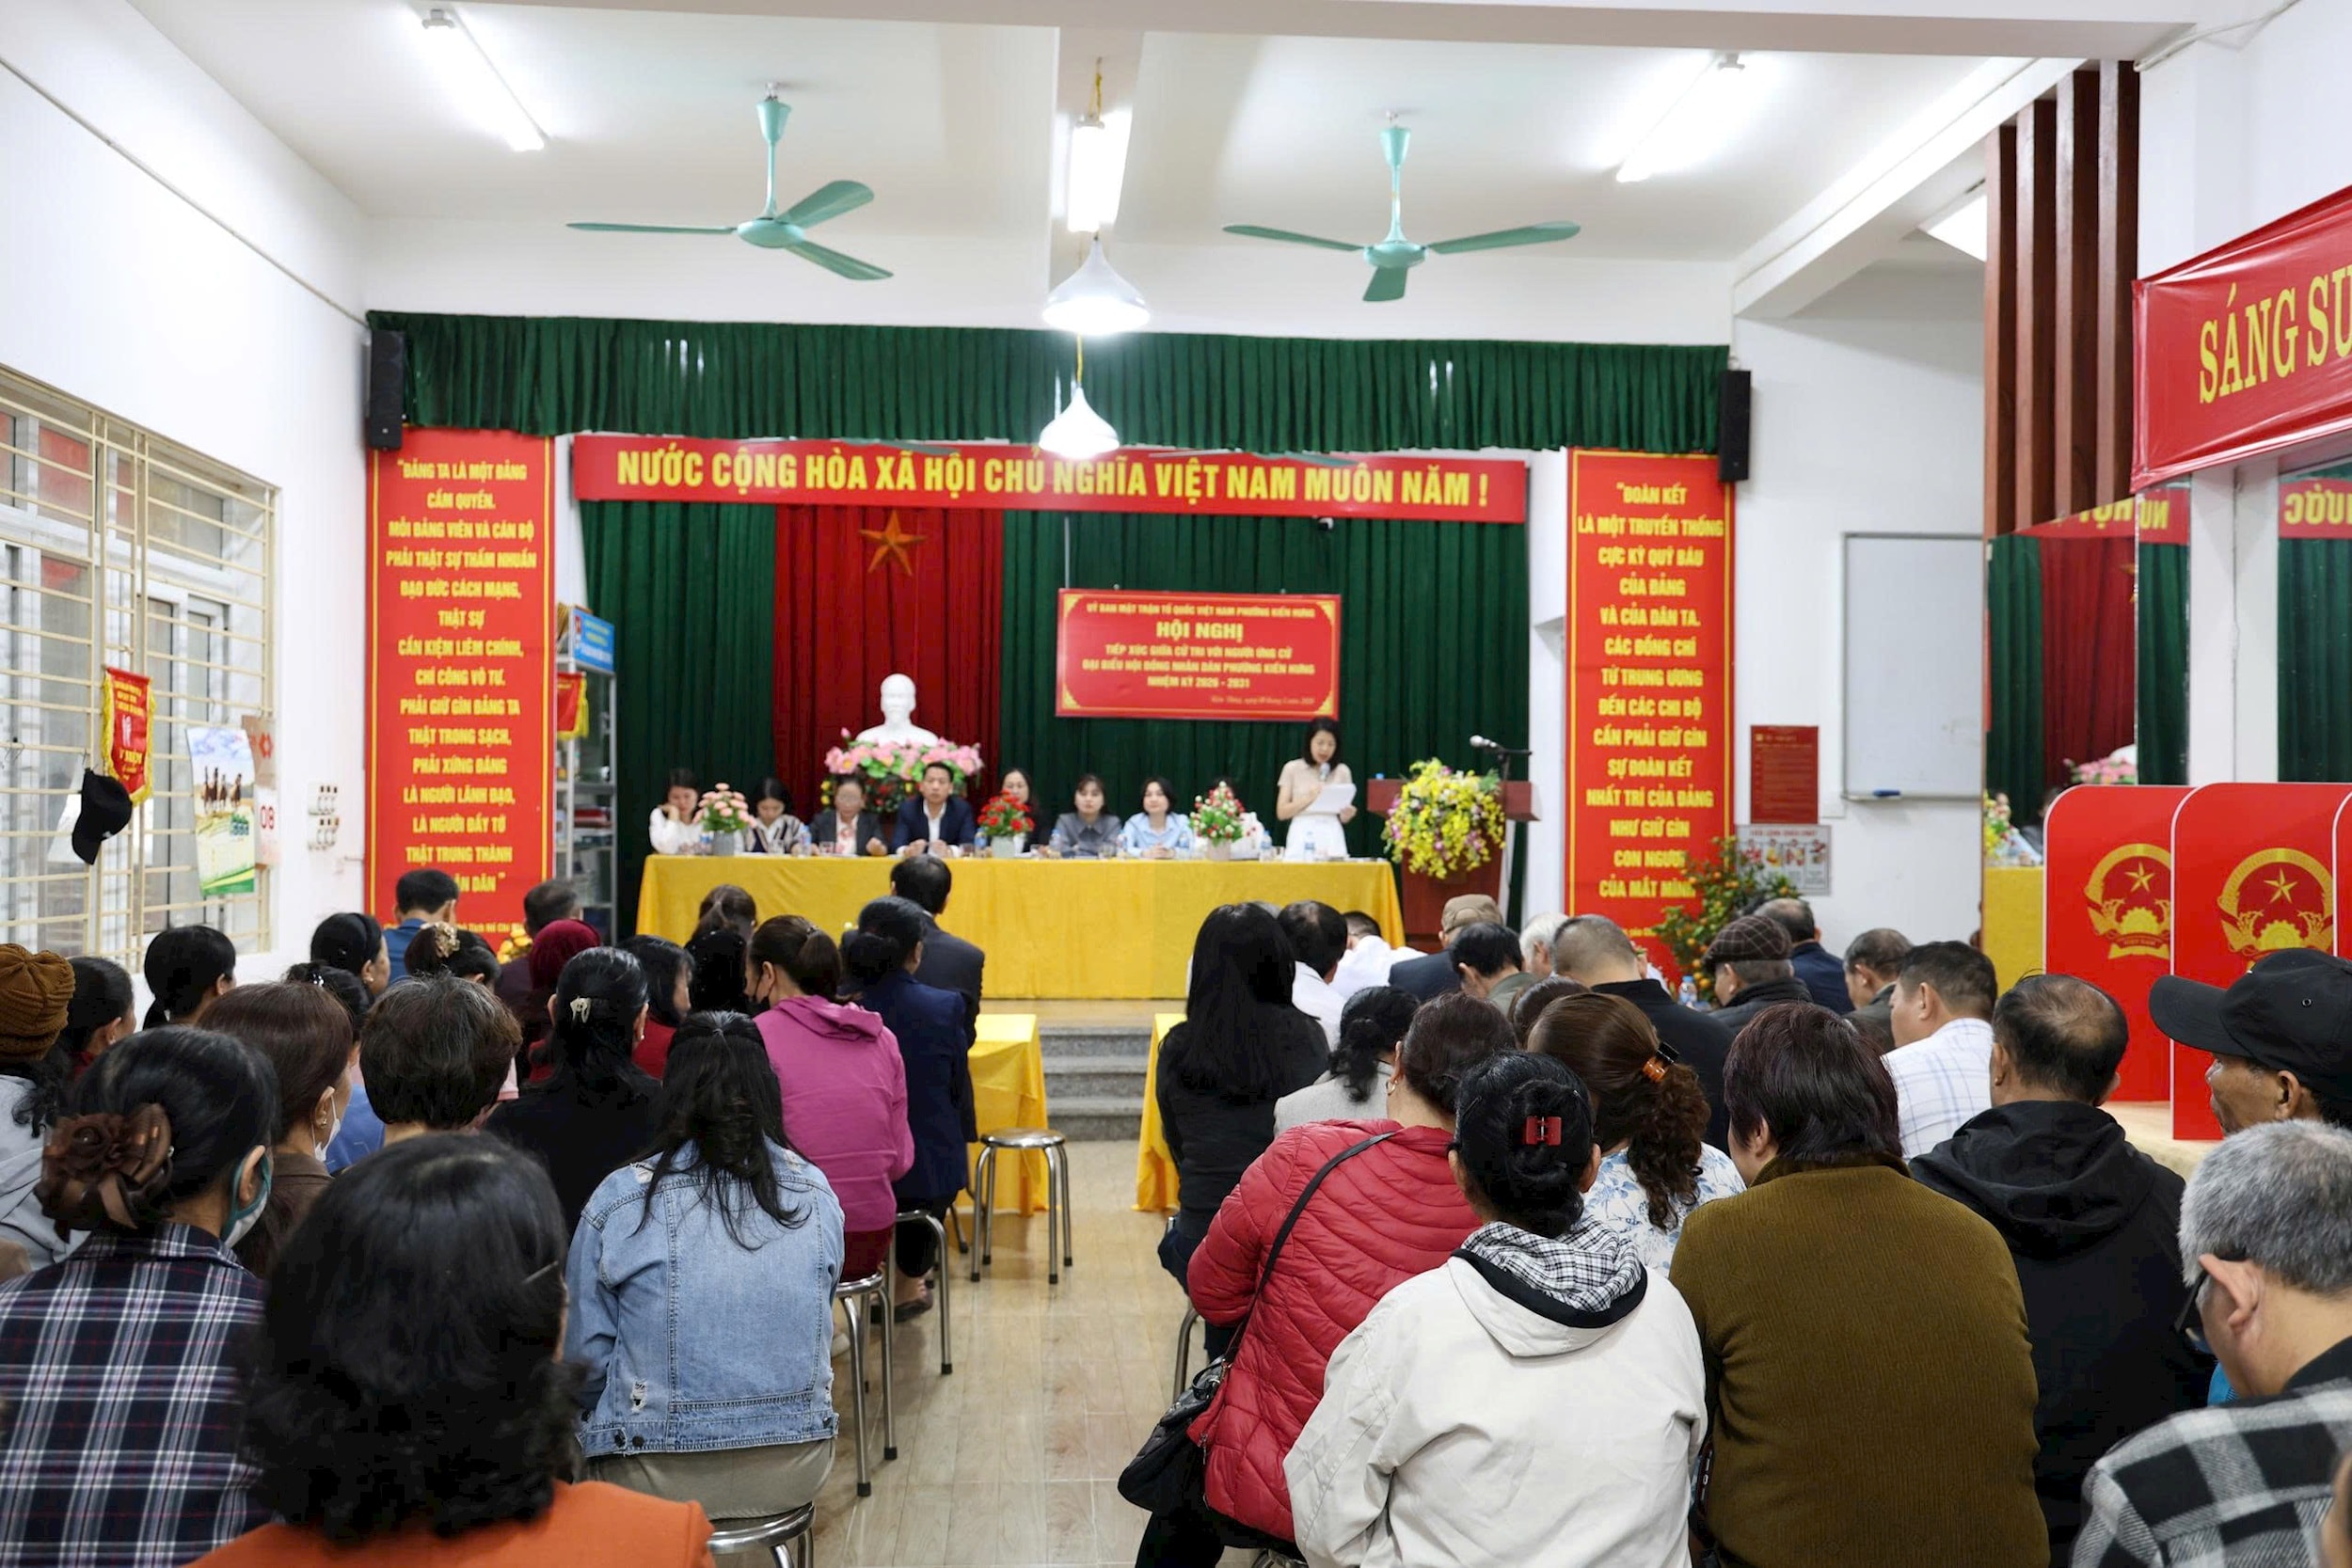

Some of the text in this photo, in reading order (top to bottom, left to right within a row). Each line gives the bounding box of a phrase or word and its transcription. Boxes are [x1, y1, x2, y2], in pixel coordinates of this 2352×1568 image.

[2200, 282, 2298, 404] SÁNG
[617, 442, 1488, 507] NƯỚC CỘNG HÒA XÃ HỘI CHỦ NGHĨA VIỆT NAM MUÔN NĂM !
[1156, 619, 1243, 642] HỘI NGHỊ
